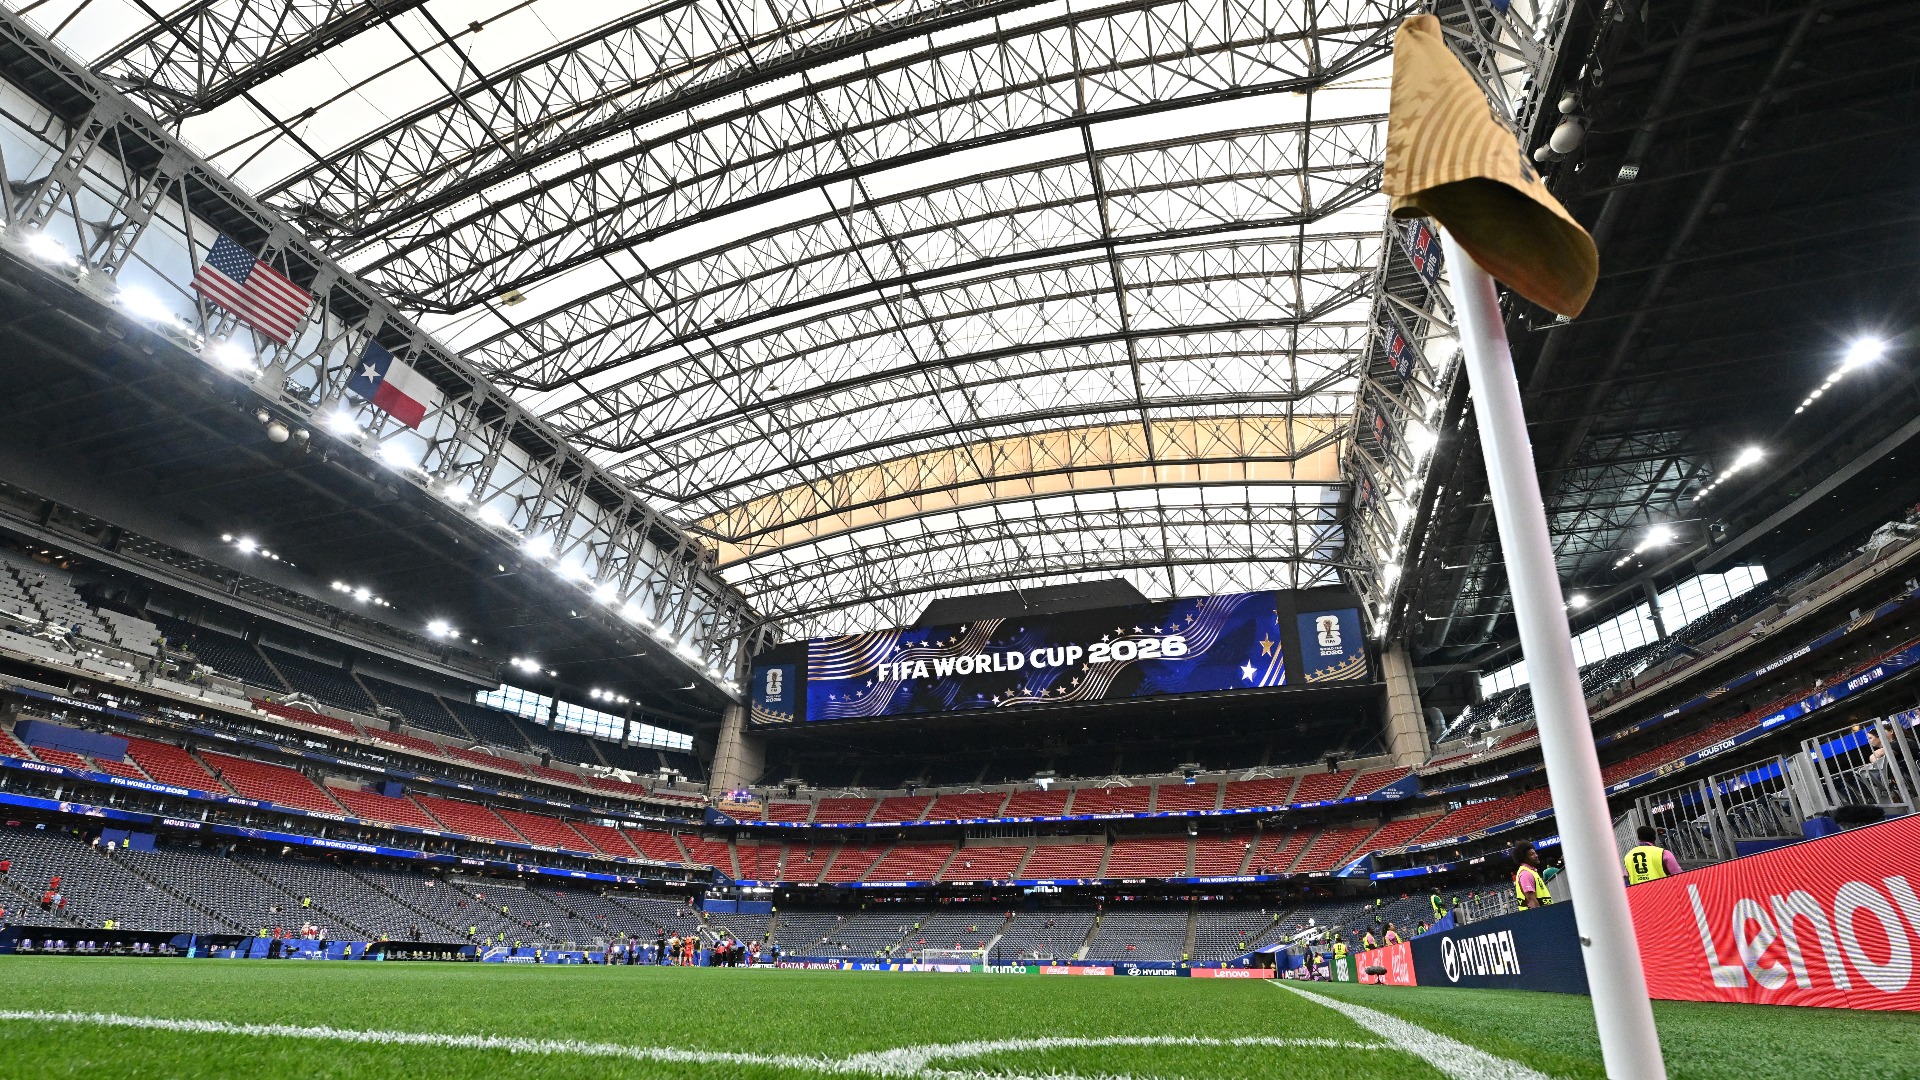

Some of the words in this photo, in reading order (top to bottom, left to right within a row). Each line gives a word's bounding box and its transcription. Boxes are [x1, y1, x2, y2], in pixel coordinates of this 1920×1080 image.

[878, 660, 929, 682] FIFA
[932, 650, 1025, 676] WORLD
[1030, 644, 1082, 669] CUP
[1087, 635, 1189, 664] 2026
[1756, 668, 1766, 676] FIFA
[1766, 660, 1783, 671] WORLD
[1783, 655, 1793, 663] CUP
[1848, 667, 1883, 690] HOUSTON
[52, 696, 102, 712] HOUSTON
[1698, 739, 1734, 758] HOUSTON
[22, 762, 63, 774] HOUSTON
[127, 780, 151, 790] WORLD
[166, 787, 188, 796] 2026
[228, 798, 258, 806] HOUSTON
[164, 819, 200, 829] HOUSTON
[307, 811, 345, 821] HOUSTON
[1457, 930, 1520, 975] HYUNDAI
[1215, 969, 1250, 978] Lenovo
